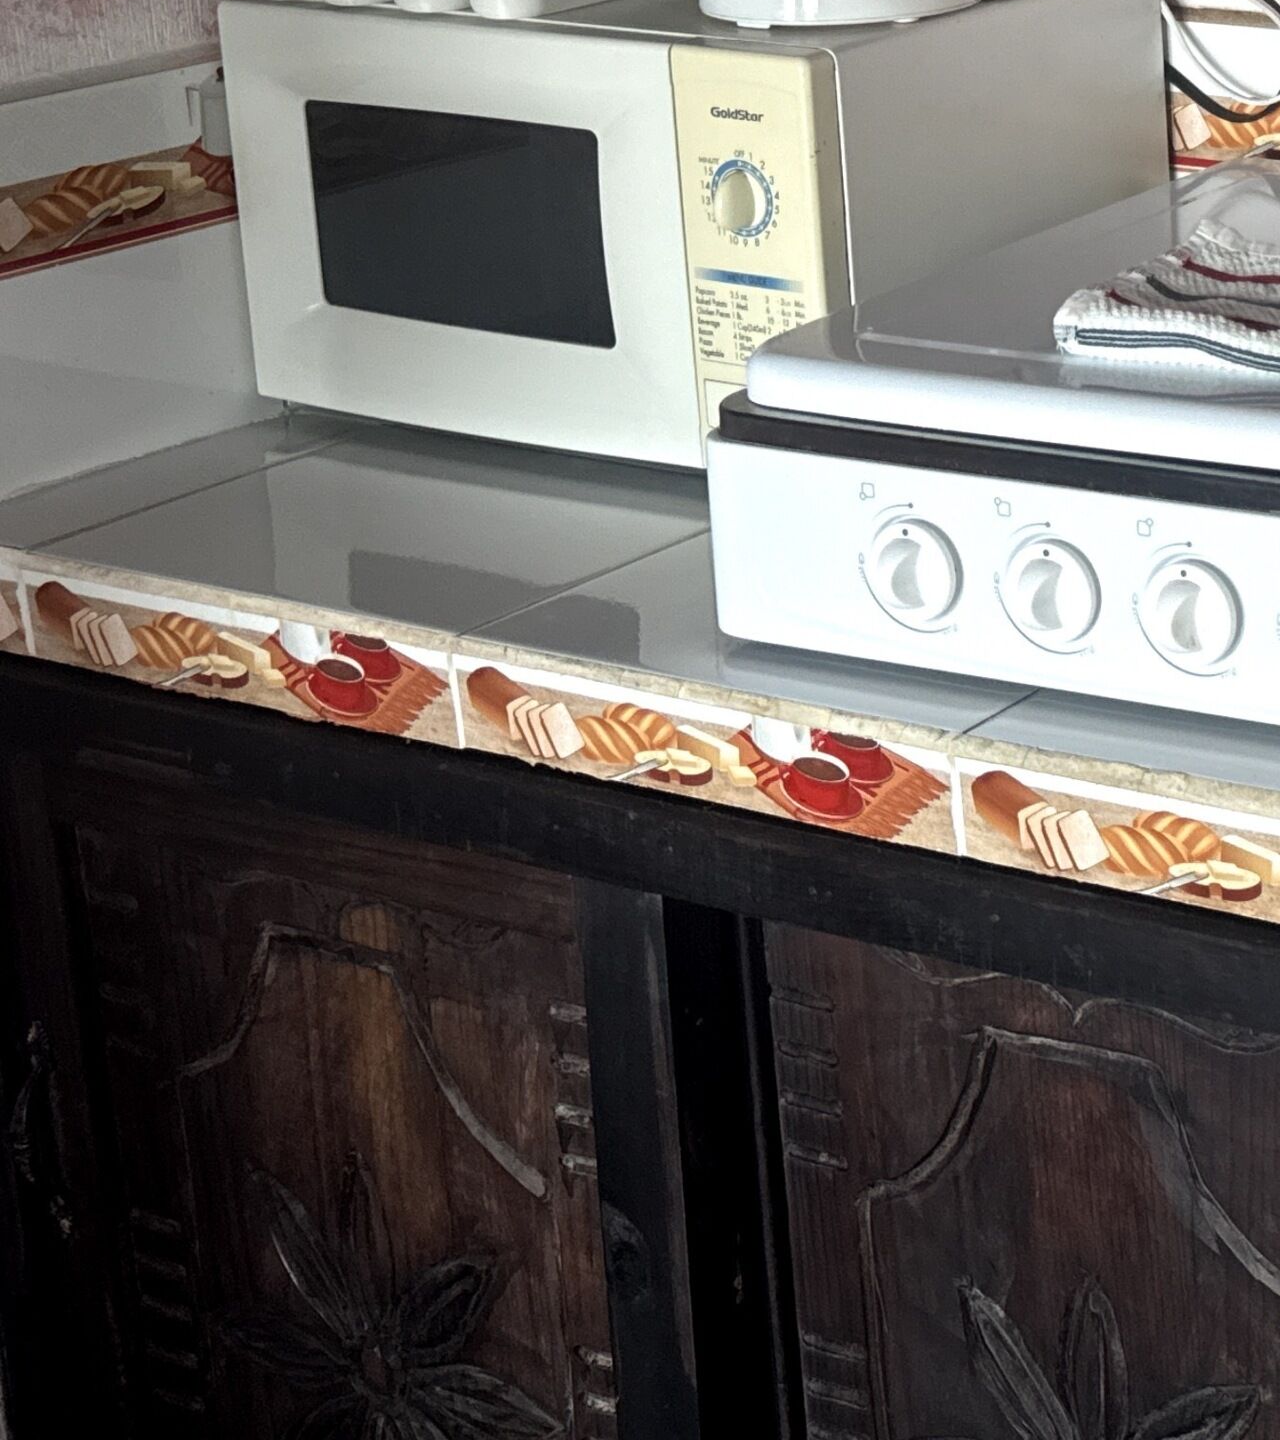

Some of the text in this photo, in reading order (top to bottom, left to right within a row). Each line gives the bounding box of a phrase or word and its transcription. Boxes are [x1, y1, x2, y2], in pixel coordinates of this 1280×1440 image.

[710, 106, 764, 122] GoldStar
[734, 149, 745, 158] OFF
[759, 160, 766, 170] 2
[704, 166, 714, 176] 15
[700, 180, 710, 189] 14
[769, 176, 775, 185] 3
[701, 195, 711, 206] 13
[774, 192, 780, 200] 4
[774, 205, 780, 215] 5
[771, 220, 778, 228] 6
[729, 235, 739, 245] 10
[764, 231, 771, 240] 7
[743, 238, 749, 248] 9
[754, 238, 760, 247] 8
